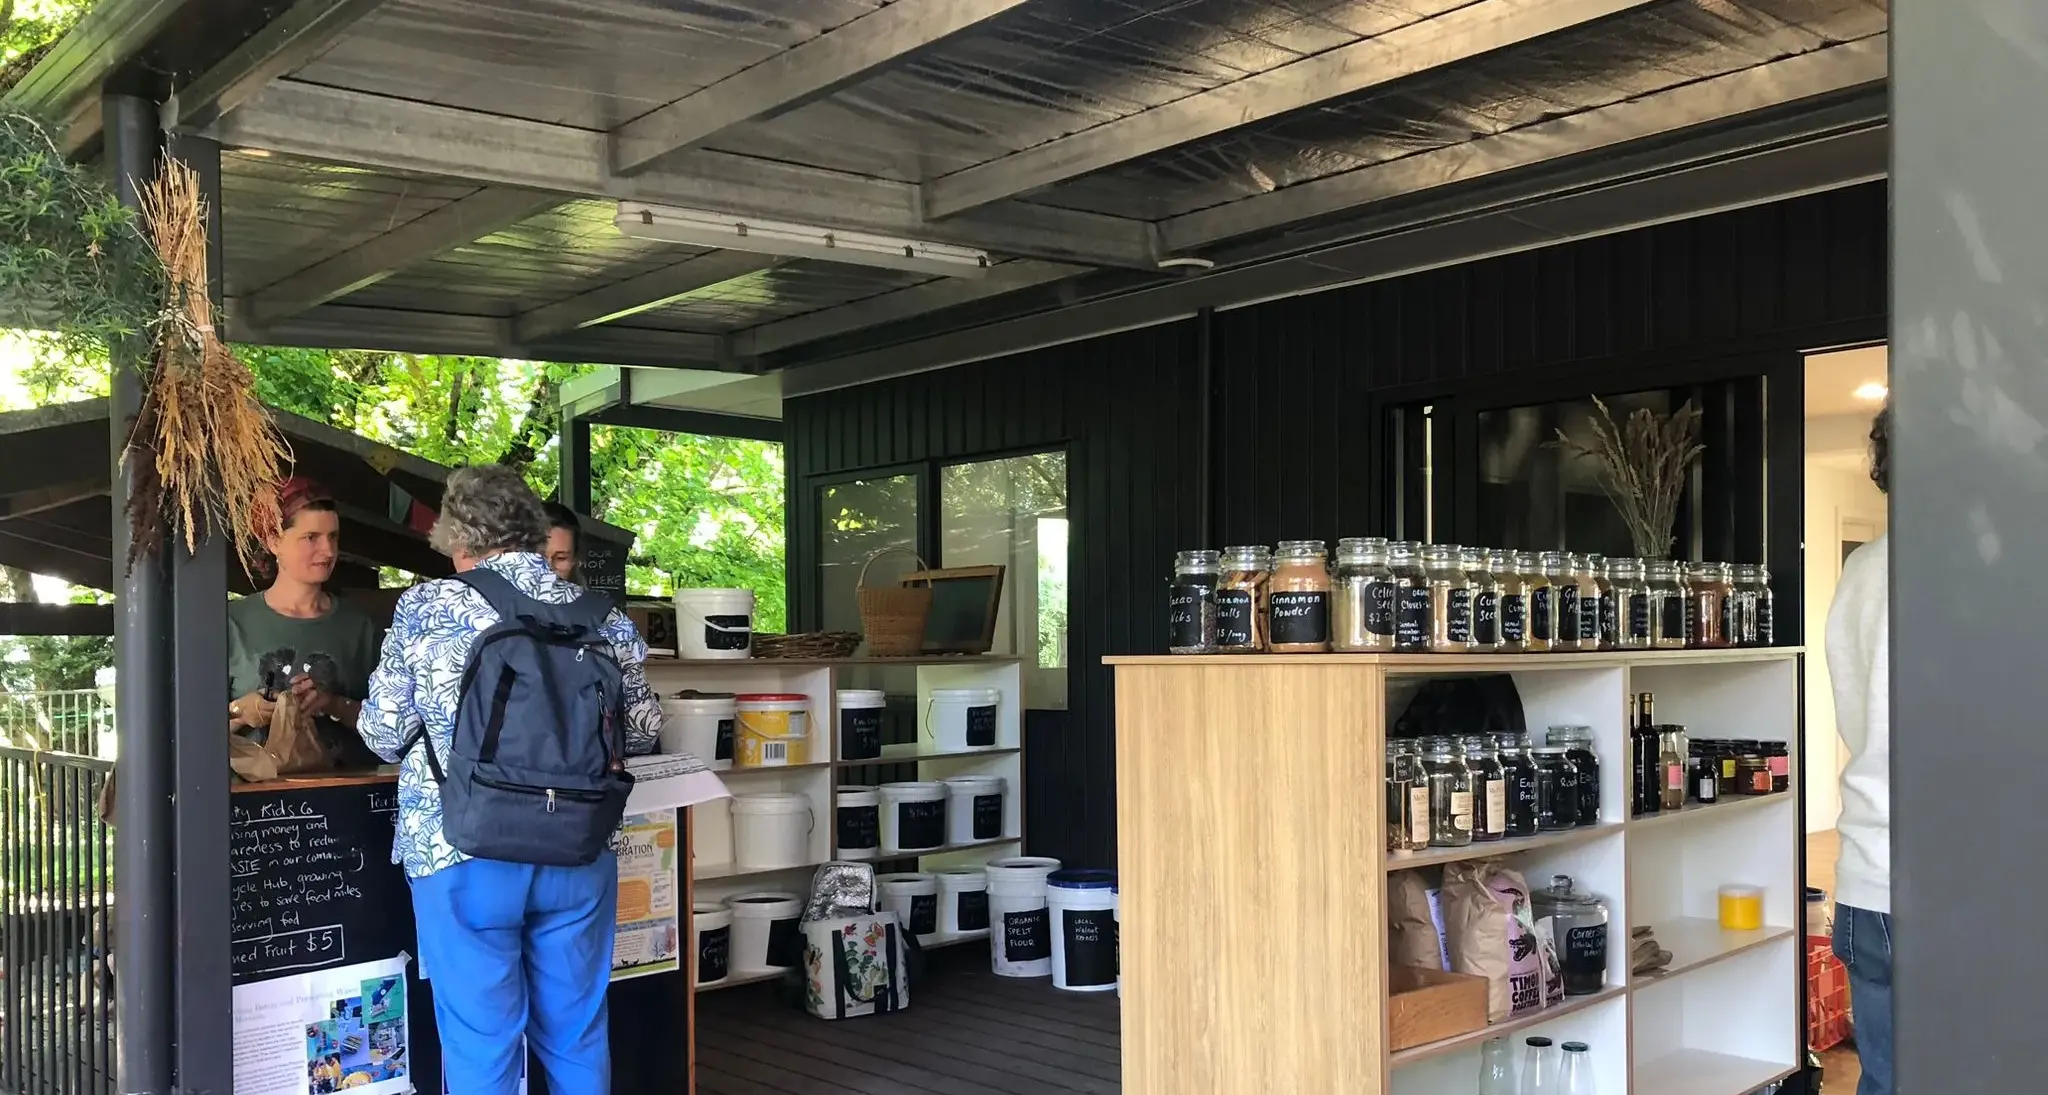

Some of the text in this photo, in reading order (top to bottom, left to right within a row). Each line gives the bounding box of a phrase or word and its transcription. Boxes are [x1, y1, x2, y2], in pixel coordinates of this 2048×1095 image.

[1271, 595, 1320, 605] Cinnamon
[1274, 606, 1312, 619] Powder
[261, 799, 295, 818] Kids
[262, 825, 299, 842] money
[305, 816, 328, 830] and
[289, 837, 301, 851] to
[283, 855, 302, 867] our
[297, 871, 344, 894] growing
[260, 896, 270, 908] to
[276, 893, 300, 907] save
[1008, 916, 1041, 926] ORGANIC
[1007, 926, 1033, 936] SPELT
[265, 939, 298, 958] Fruit
[1010, 938, 1036, 947] FLOUR
